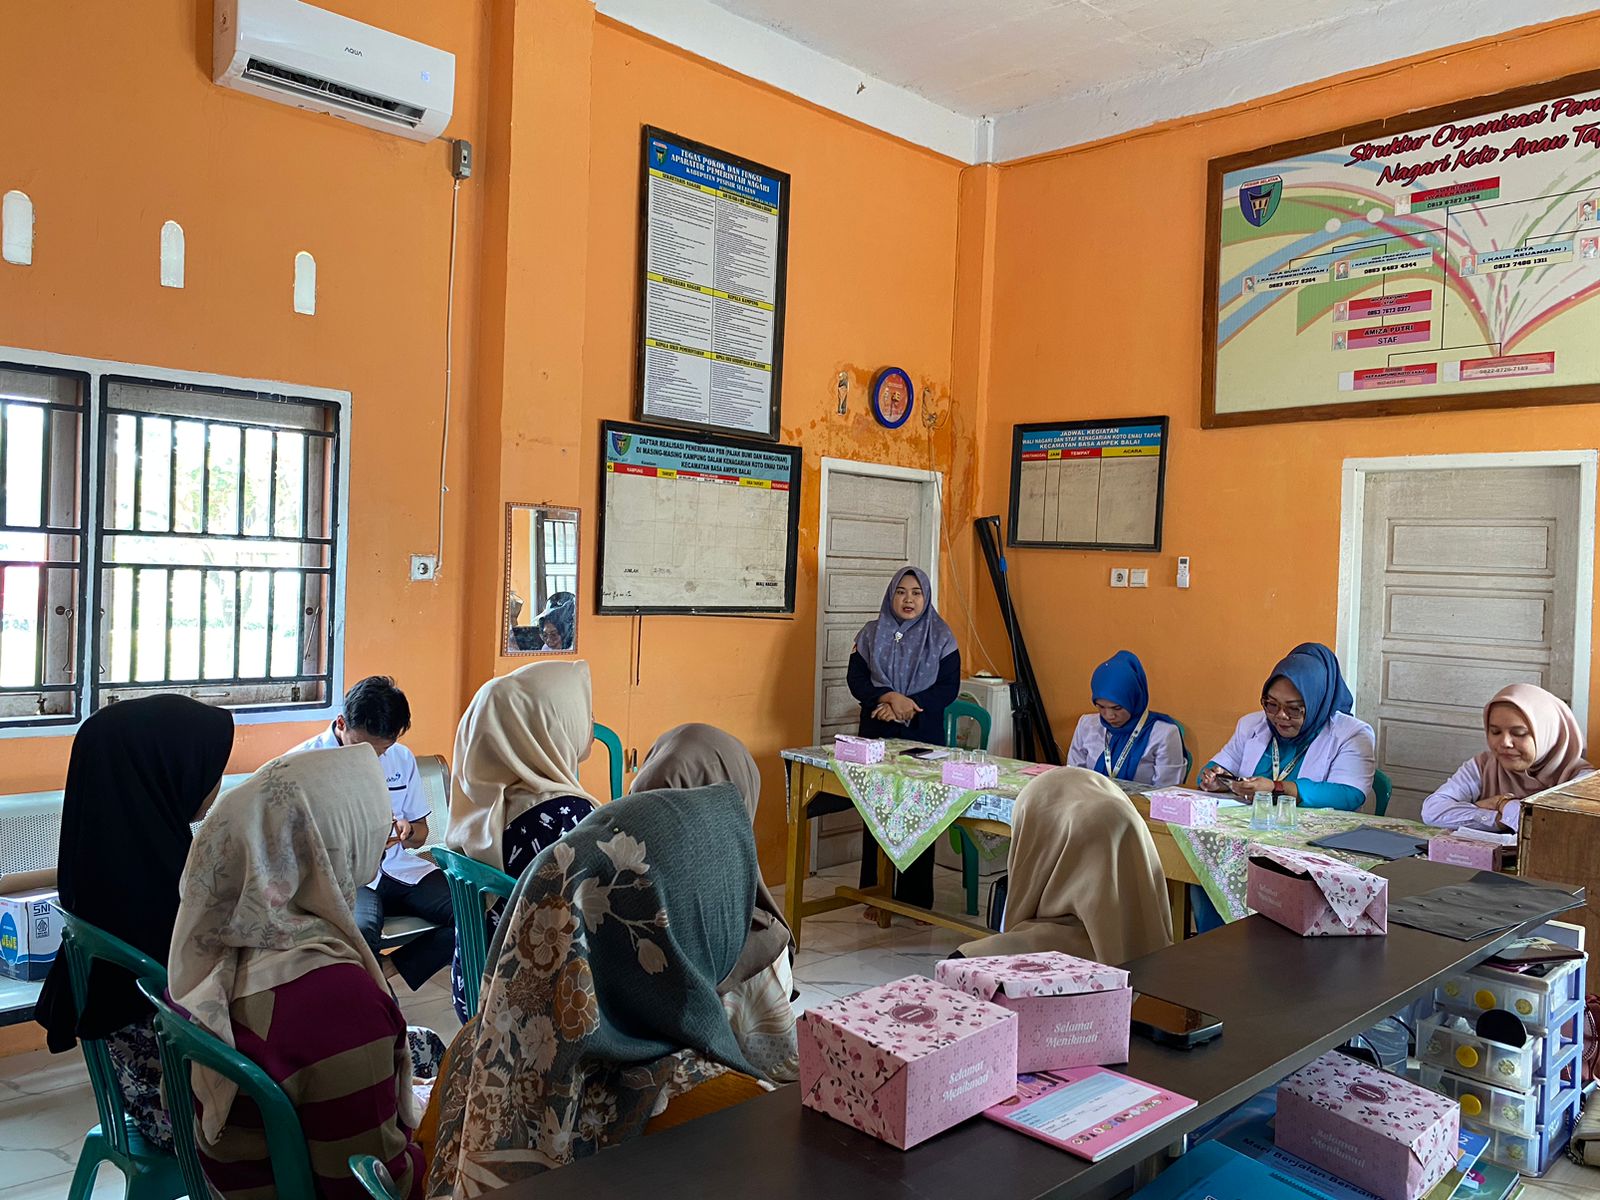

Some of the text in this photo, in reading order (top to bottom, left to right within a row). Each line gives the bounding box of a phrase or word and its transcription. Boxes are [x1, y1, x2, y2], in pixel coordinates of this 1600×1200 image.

[344, 46, 363, 56] AQUA
[1343, 133, 1431, 167] Struktur
[1432, 104, 1549, 149] Organisasi
[671, 153, 705, 171] APARATUR
[702, 156, 726, 171] POKOK
[727, 164, 740, 175] DAN
[1376, 153, 1452, 187] Nagari
[1450, 144, 1500, 171] Koto
[1499, 134, 1570, 162] Anau
[1487, 254, 1511, 262] KAUR
[1513, 247, 1562, 258] KEUANGAN
[1364, 324, 1414, 336] AMIZA PUTRI
[1377, 336, 1398, 345] STAF
[639, 437, 659, 447] DAFTAR
[659, 439, 685, 450] REALISASI
[753, 452, 762, 460] DAN
[682, 452, 707, 462] KAMPUNG
[680, 460, 710, 471] KECAMATAN
[33, 903, 51, 914] SNI
[1054, 1020, 1094, 1033] Selamat
[1046, 1031, 1100, 1048] Menikmati
[949, 1060, 985, 1084] Selamat
[942, 1070, 989, 1102] Menikmati
[1242, 1137, 1272, 1153] Mari
[1273, 1150, 1327, 1179] Berjalan
